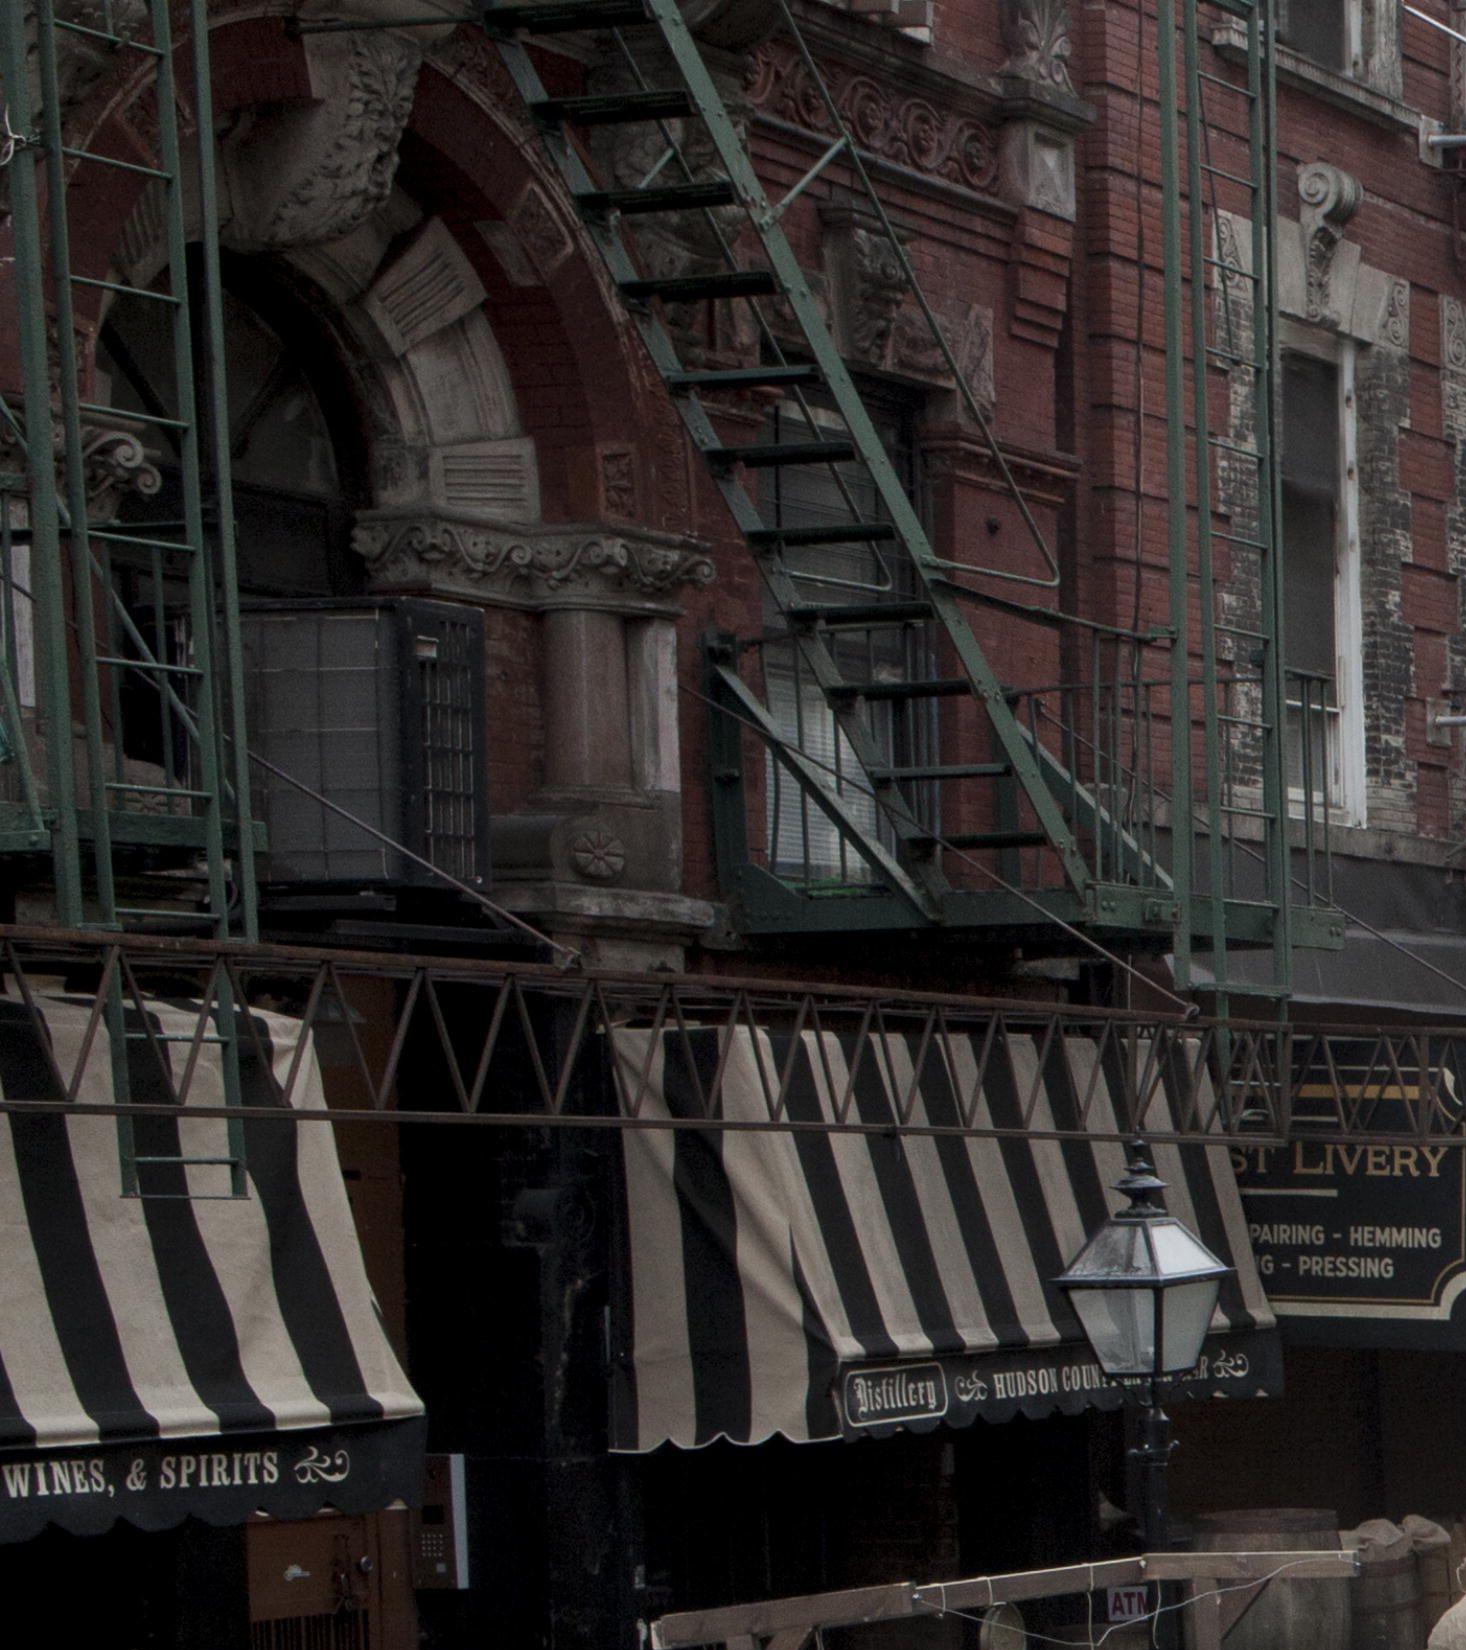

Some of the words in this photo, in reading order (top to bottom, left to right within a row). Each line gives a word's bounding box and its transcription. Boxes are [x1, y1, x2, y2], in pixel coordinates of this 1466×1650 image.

[1293, 1141, 1449, 1178] LIVERY
[1250, 1223, 1325, 1246] PAIRING
[1350, 1225, 1442, 1249] HEMMING
[1299, 1255, 1395, 1279] PRESSING
[853, 1371, 937, 1423] Distillery
[993, 1370, 1060, 1400] HUDSON
[1061, 1362, 1118, 1392] COUN
[1, 1458, 116, 1498] WINES,
[126, 1458, 147, 1491] &
[159, 1450, 280, 1490] SPIRITS
